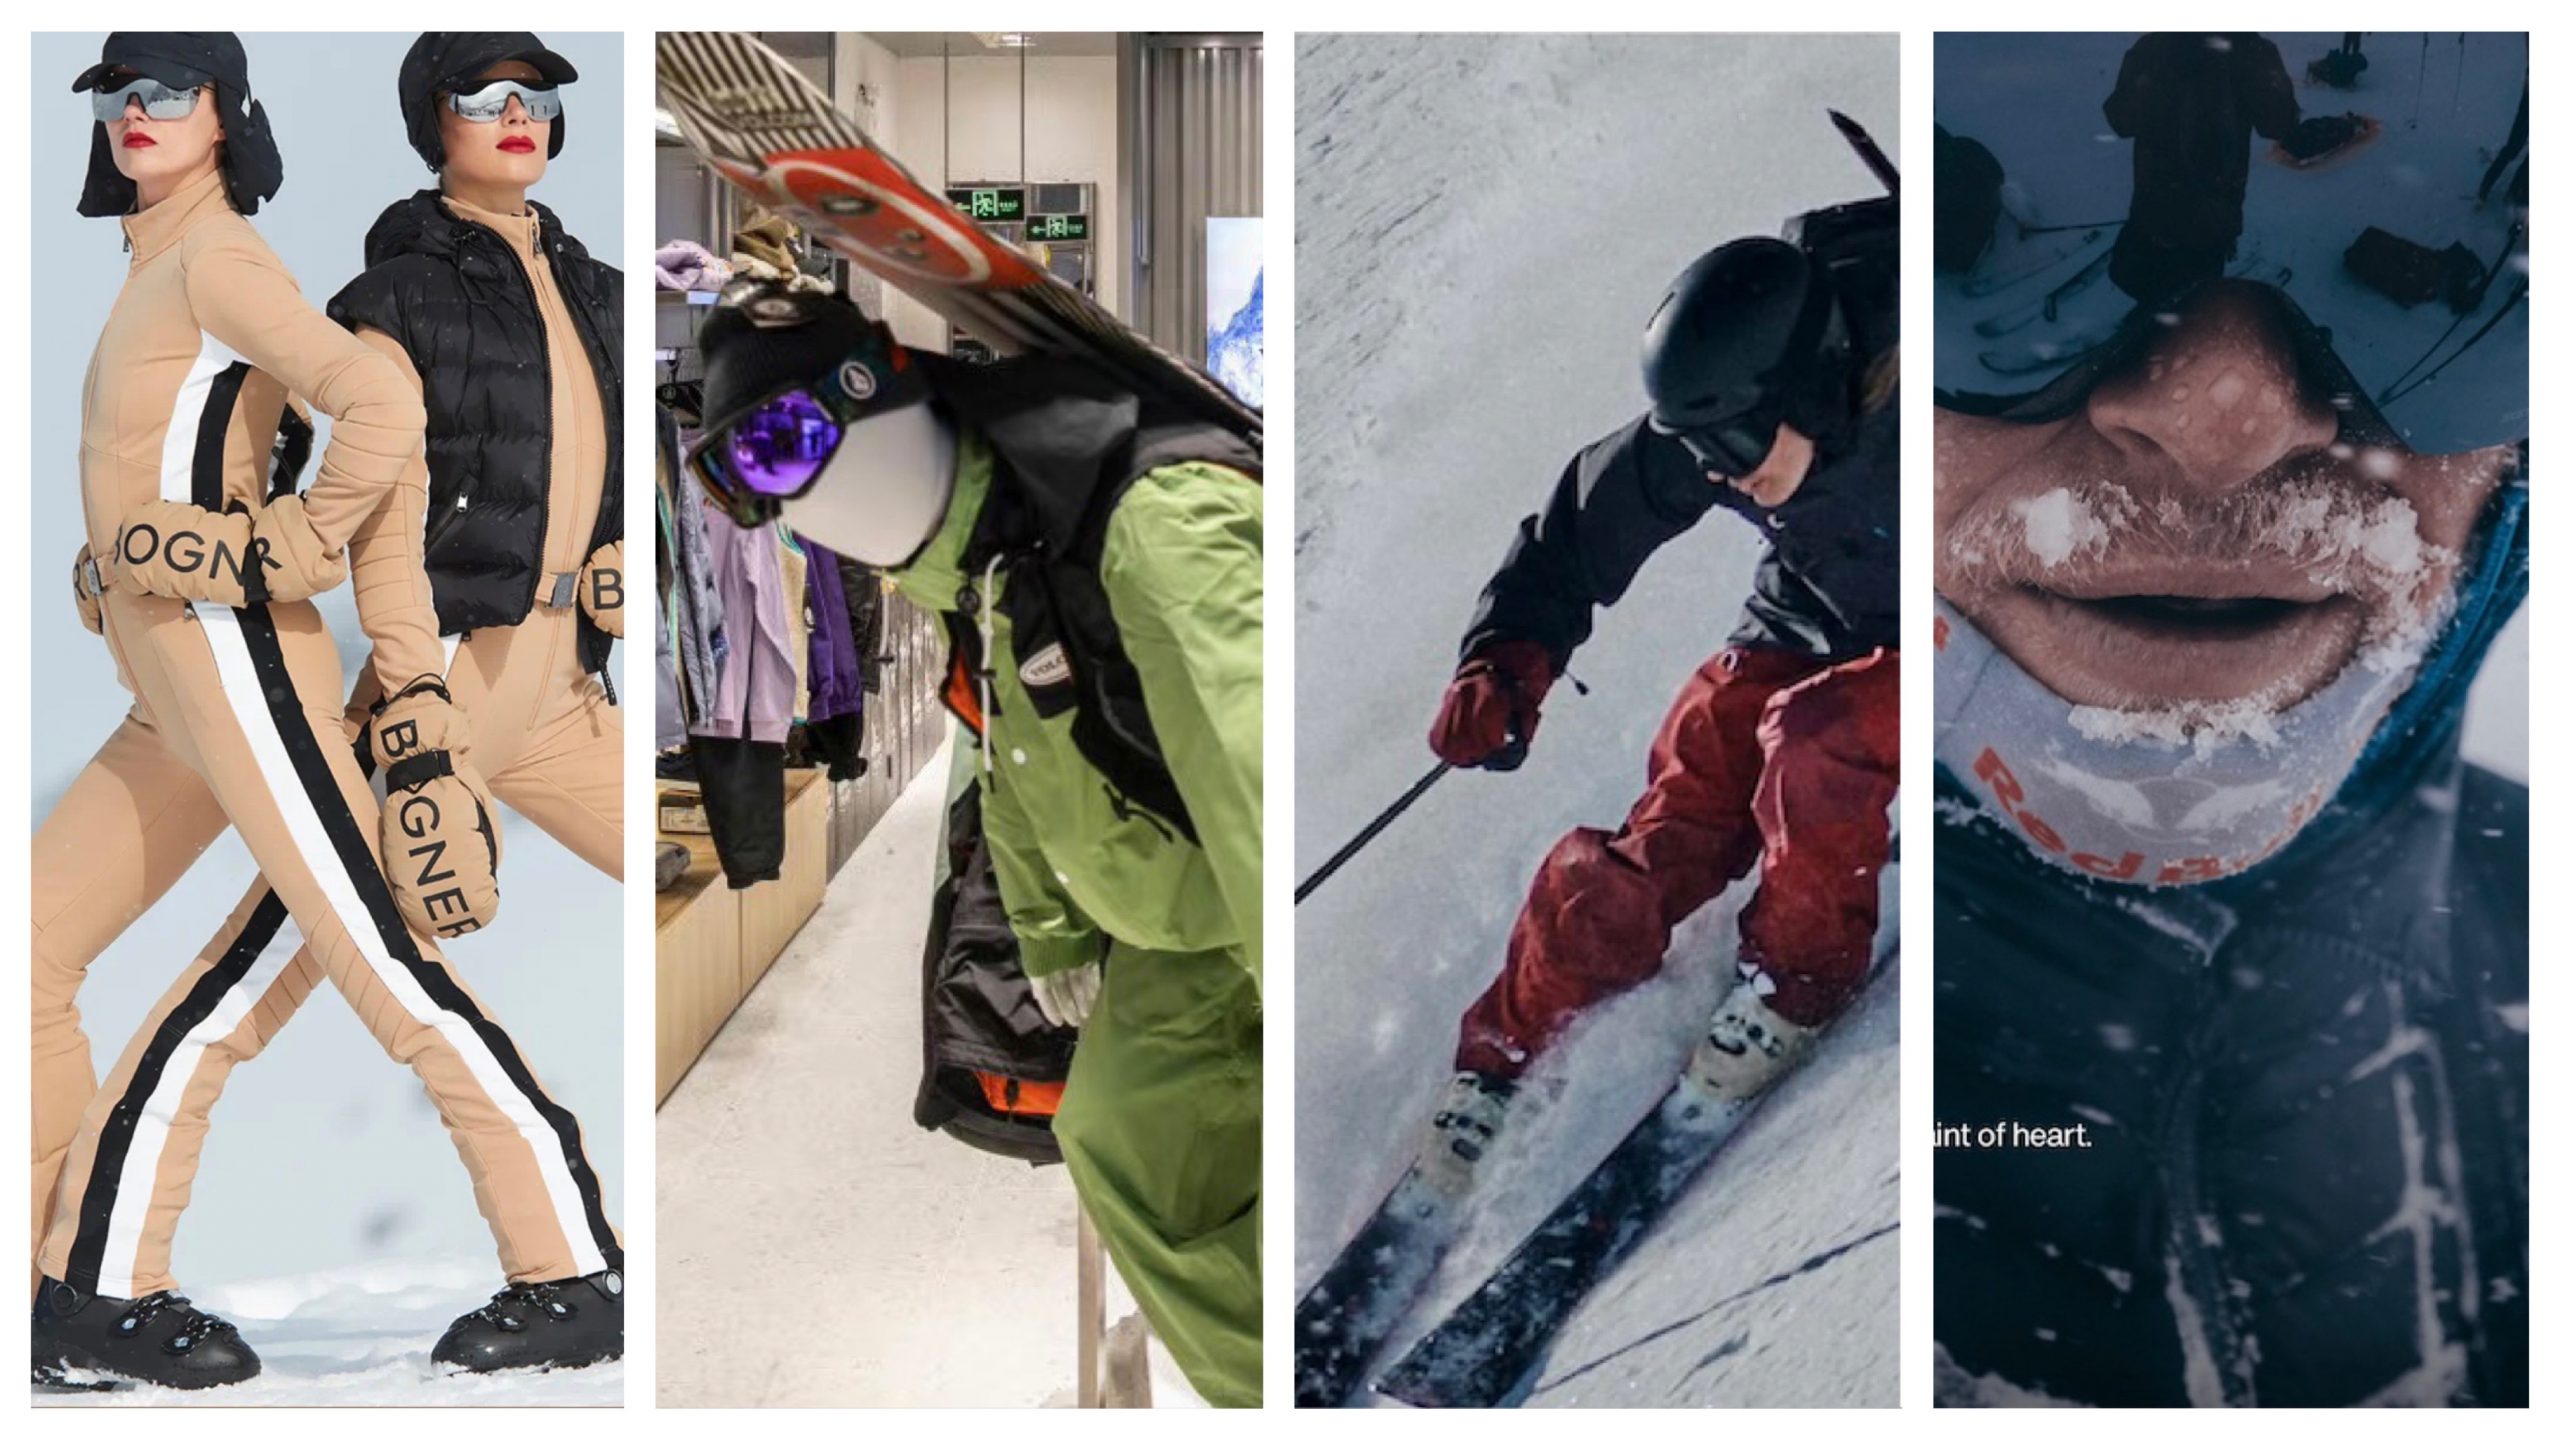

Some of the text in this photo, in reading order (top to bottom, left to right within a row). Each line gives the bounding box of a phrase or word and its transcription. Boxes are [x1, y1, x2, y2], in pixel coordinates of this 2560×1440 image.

[114, 523, 283, 587] OGNR
[592, 568, 624, 610] B
[379, 719, 482, 938] BGNER
[1973, 746, 2145, 880] Red
